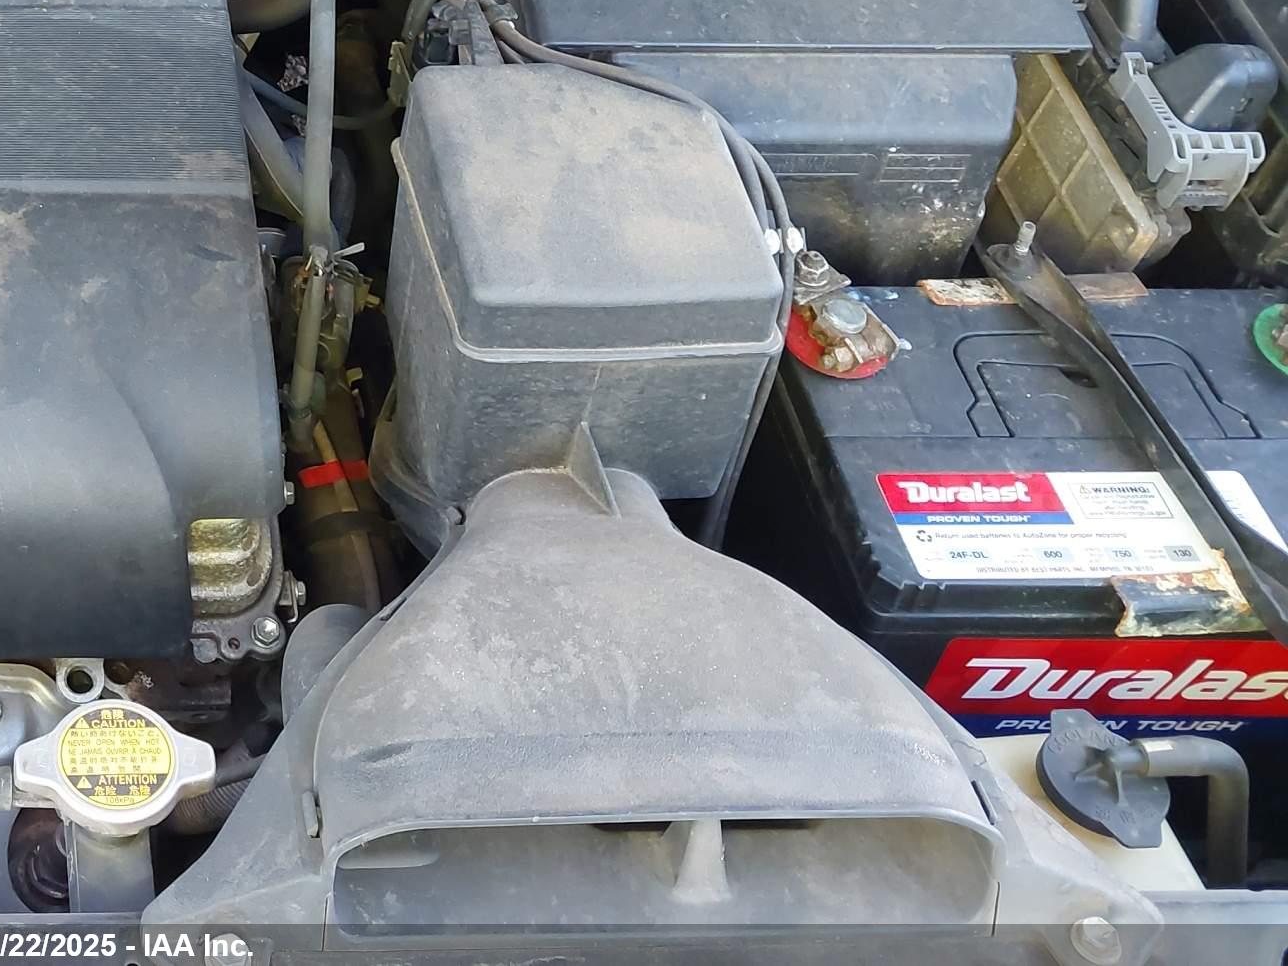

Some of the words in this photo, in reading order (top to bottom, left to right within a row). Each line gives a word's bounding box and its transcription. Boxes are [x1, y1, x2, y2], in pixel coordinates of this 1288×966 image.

[896, 481, 1032, 503] Duralast
[926, 514, 980, 523] PROVEN
[949, 550, 989, 559] 24F-DL
[1044, 550, 1063, 559] 600
[1112, 549, 1131, 558] 750
[1173, 549, 1192, 558] 130
[962, 658, 1288, 701] Duralas
[91, 719, 146, 729] CAUTION
[1137, 720, 1240, 731] TOUGH
[68, 739, 91, 747] NEVER
[120, 738, 141, 746] WHEN
[139, 747, 162, 755] CHAUD
[98, 774, 158, 785] ATTENTION
